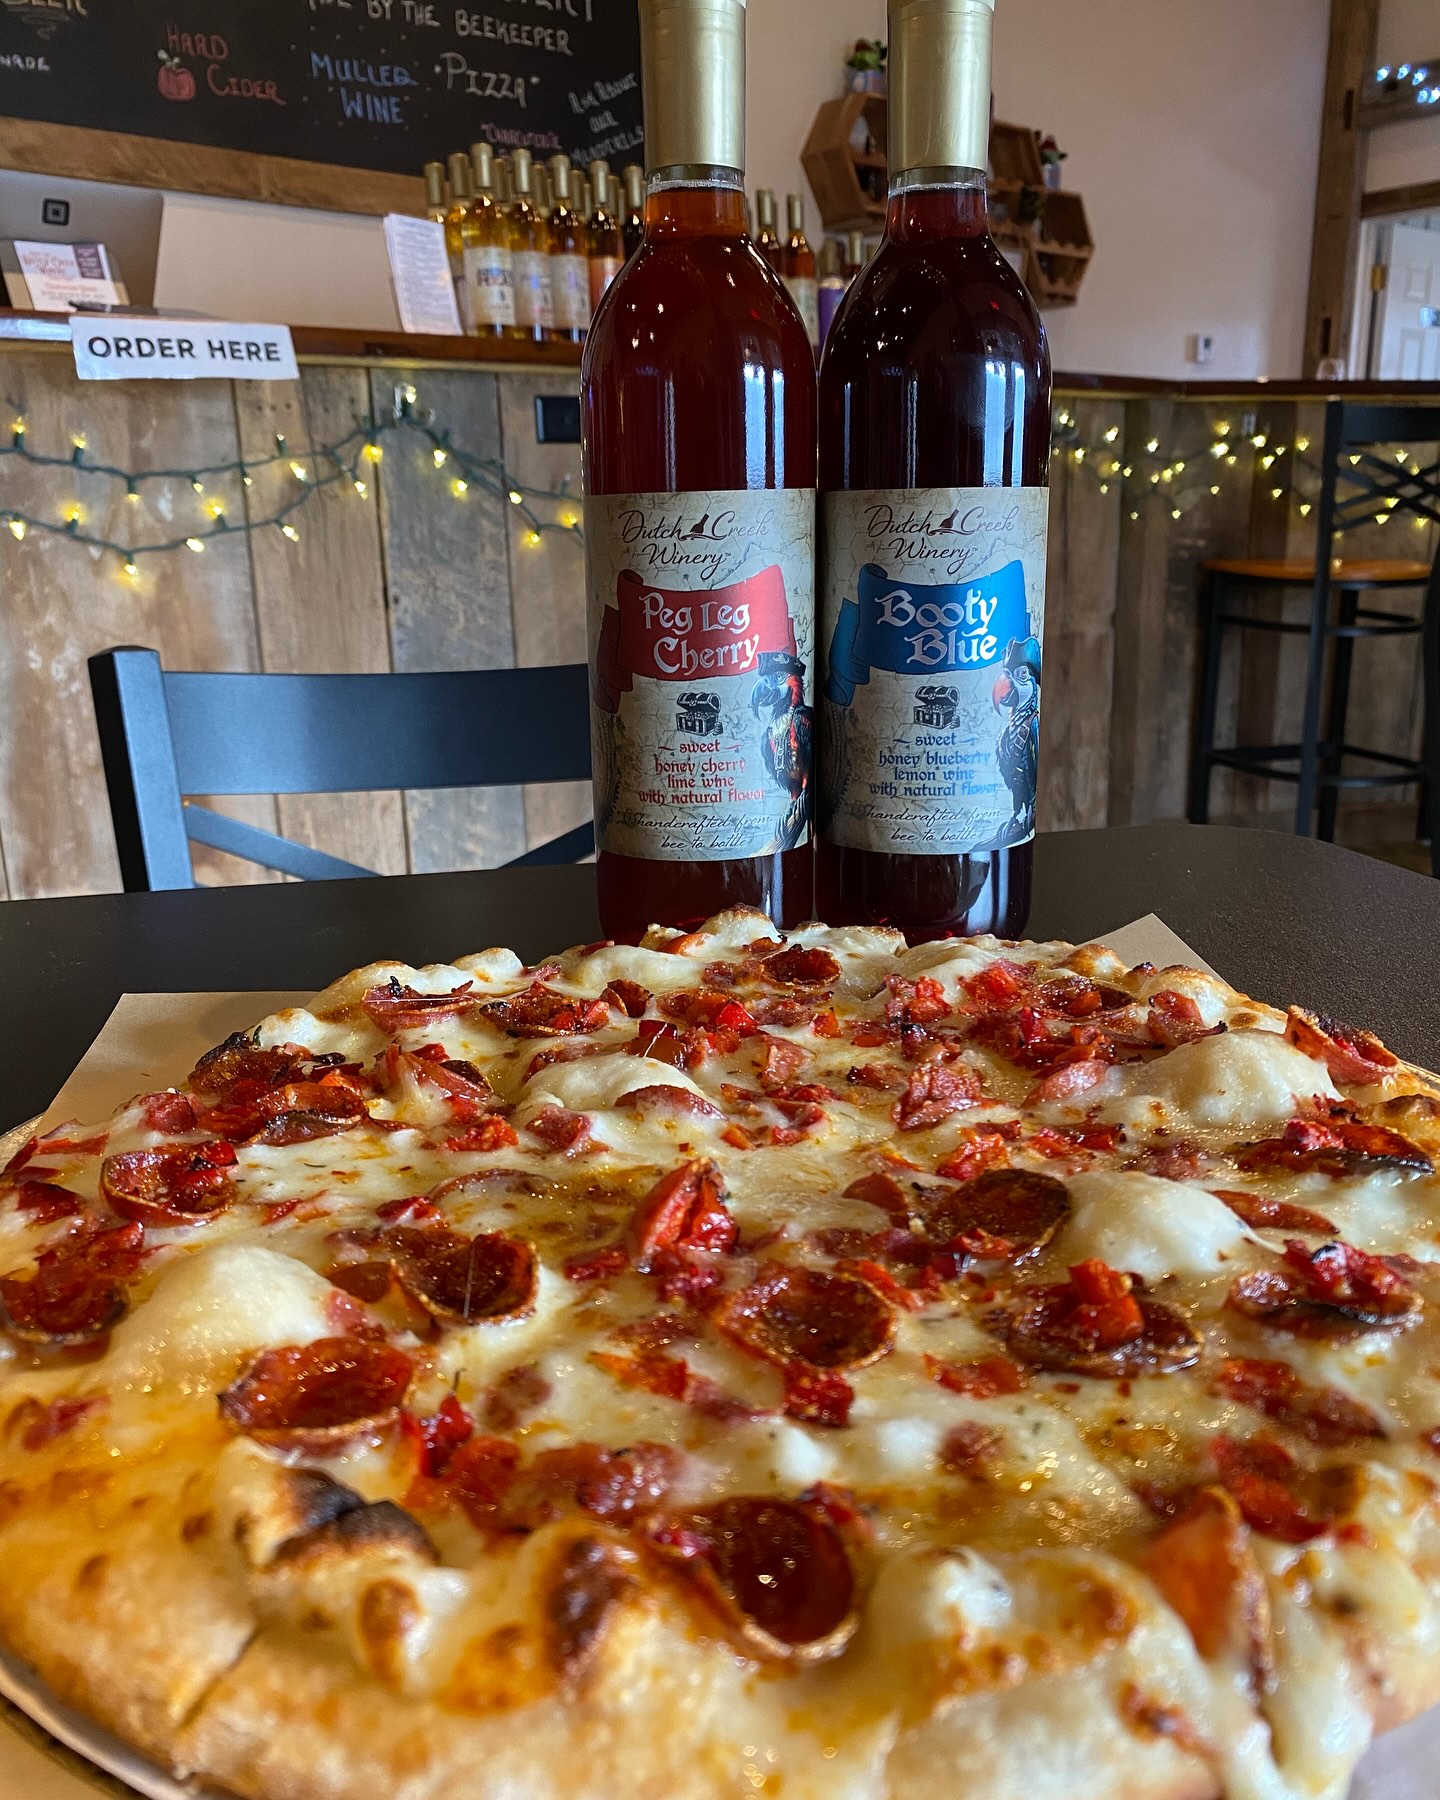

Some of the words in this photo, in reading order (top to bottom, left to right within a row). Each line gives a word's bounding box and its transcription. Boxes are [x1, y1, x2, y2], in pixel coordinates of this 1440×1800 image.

[166, 20, 228, 60] HARD
[402, 0, 441, 27] THE
[454, 8, 574, 56] BEEKEEPER
[207, 63, 287, 106] CIDER
[439, 51, 528, 109] PIZZA
[339, 87, 405, 124] WINE
[87, 336, 196, 360] ORDER
[207, 339, 281, 363] HERE
[618, 510, 687, 543] Dutch
[711, 510, 774, 541] Creek
[864, 505, 932, 538] Dutch
[960, 505, 1020, 536] Creek
[639, 592, 693, 635] Peg
[700, 602, 751, 634] Leg
[874, 588, 998, 636] Booty
[653, 634, 759, 675] Cherry
[903, 628, 998, 666] Blue
[679, 739, 721, 754] sweet
[915, 732, 957, 746] sweet
[654, 757, 695, 776] honey
[701, 758, 747, 776] cherry
[878, 750, 920, 768] honey
[926, 750, 991, 766] blueberry
[667, 775, 695, 789] lime
[701, 774, 735, 788] wine
[893, 768, 936, 781] lemon
[943, 767, 975, 780] wine
[639, 790, 665, 807] with
[671, 789, 722, 805] natural
[728, 788, 766, 802] flavor
[869, 782, 898, 799] with
[903, 782, 956, 797] natural
[960, 781, 1000, 796] flavor
[634, 814, 732, 834] handcrafted
[735, 814, 773, 834] from
[864, 805, 962, 827] handcrafted
[966, 804, 1001, 824] from
[661, 837, 688, 850] bee
[691, 838, 706, 850] to
[709, 833, 751, 849] bottle
[890, 829, 918, 841] bee
[921, 830, 935, 841] to
[940, 825, 979, 841] bottle
